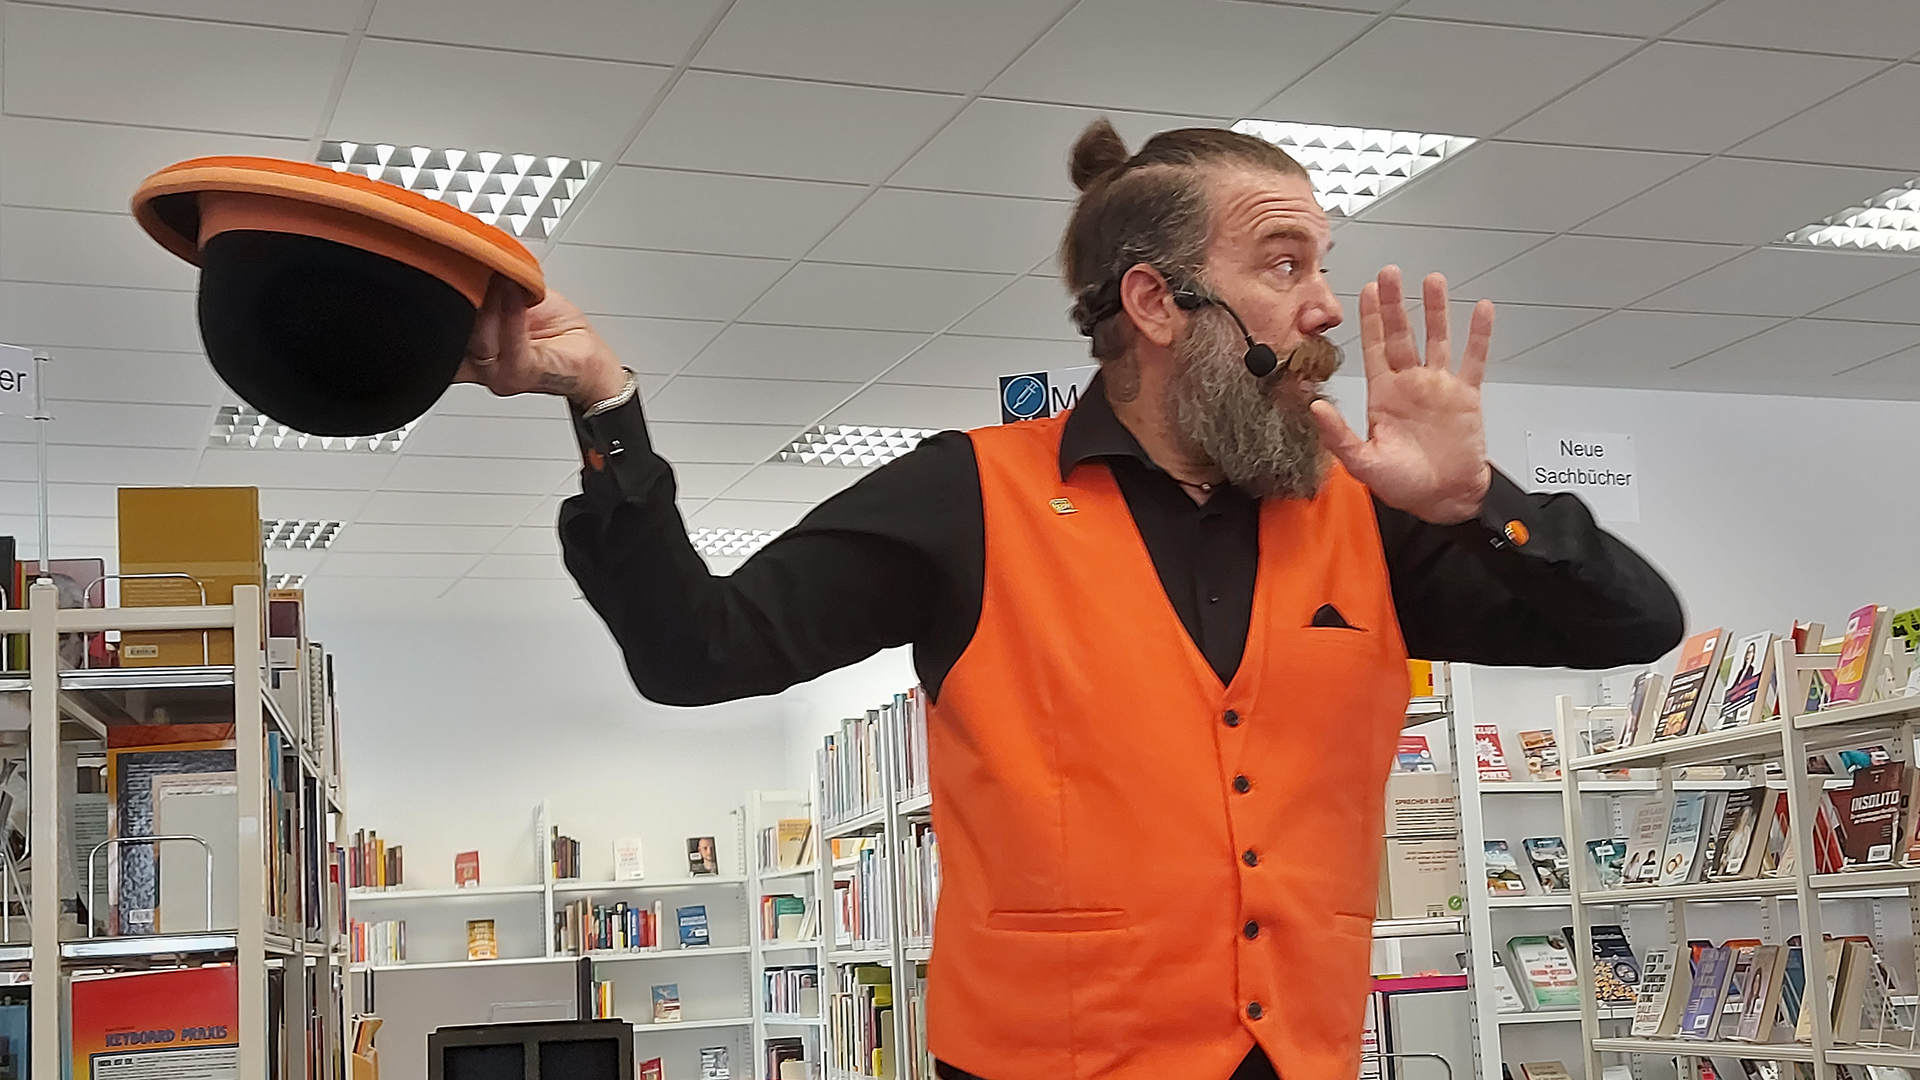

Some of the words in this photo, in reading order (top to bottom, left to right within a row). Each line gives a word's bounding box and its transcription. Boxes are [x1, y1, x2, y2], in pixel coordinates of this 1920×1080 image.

[0, 369, 27, 392] er
[1560, 440, 1604, 457] Neue
[1535, 467, 1632, 486] Sachbücher
[105, 1028, 176, 1047] KEYBOARD
[181, 1025, 228, 1041] PRAXIS
